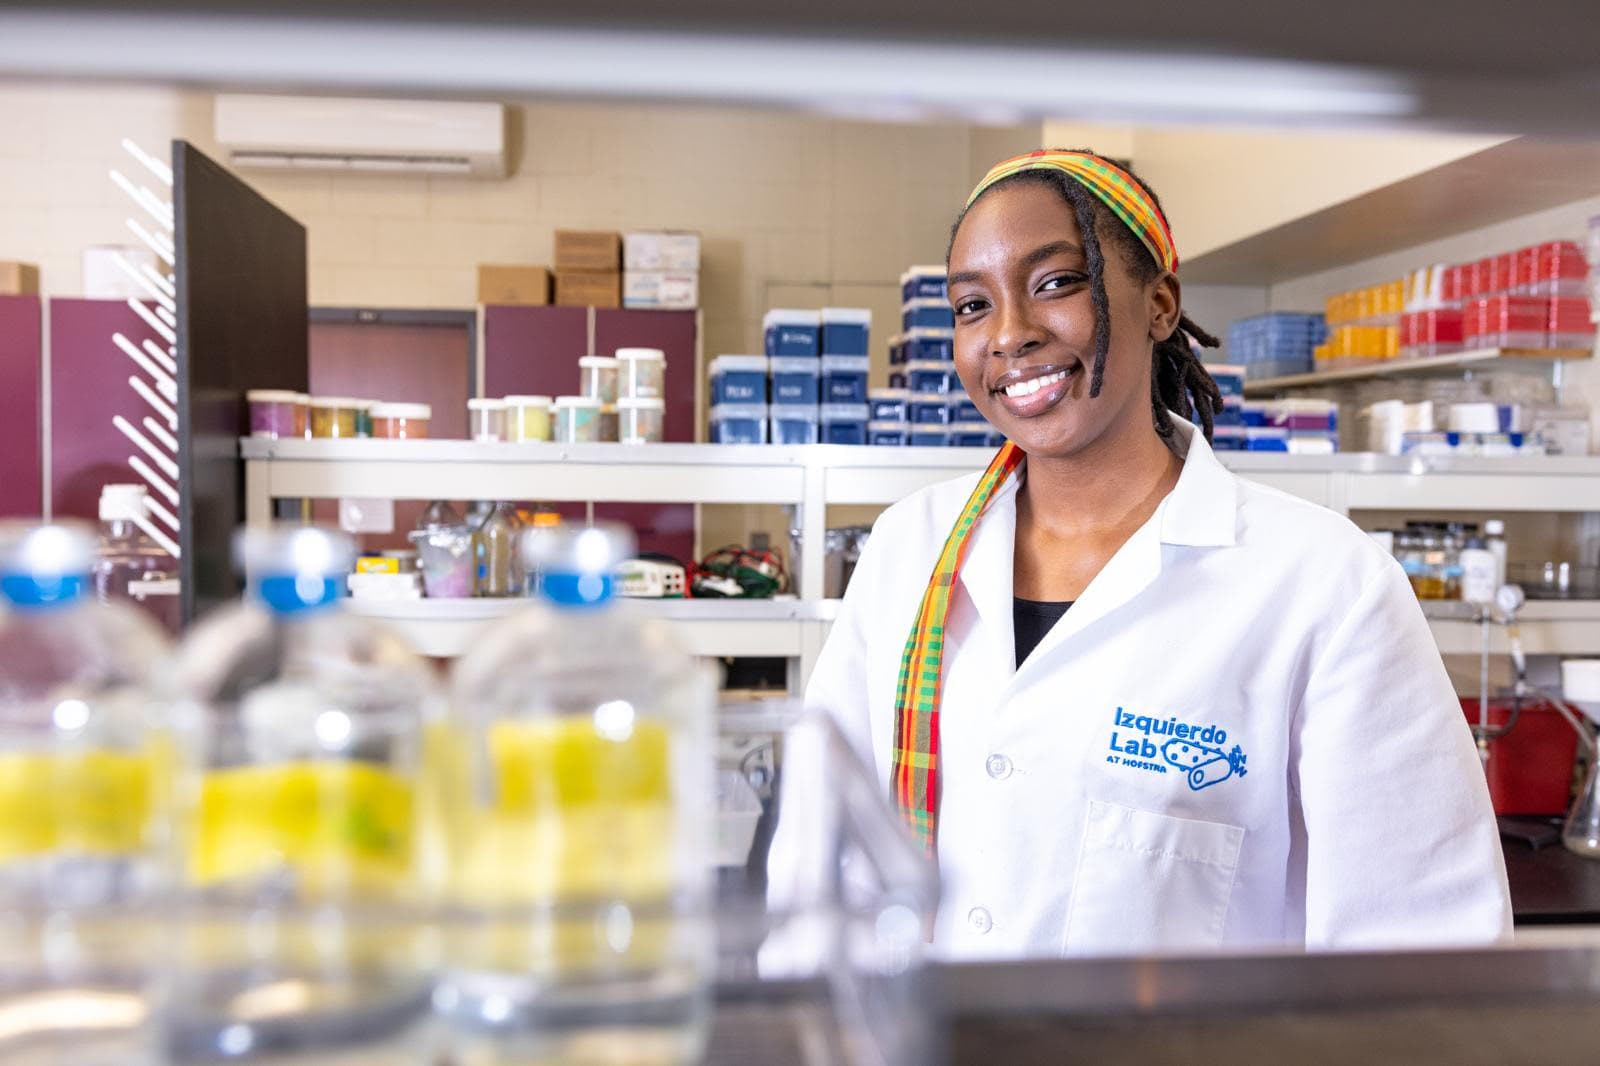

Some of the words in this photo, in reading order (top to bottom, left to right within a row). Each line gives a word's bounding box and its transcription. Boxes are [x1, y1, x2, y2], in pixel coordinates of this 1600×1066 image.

[1113, 706, 1227, 744] Izquierdo
[1109, 732, 1157, 758] Lab
[1106, 755, 1120, 764] AT
[1122, 758, 1167, 773] HOFSTRA
